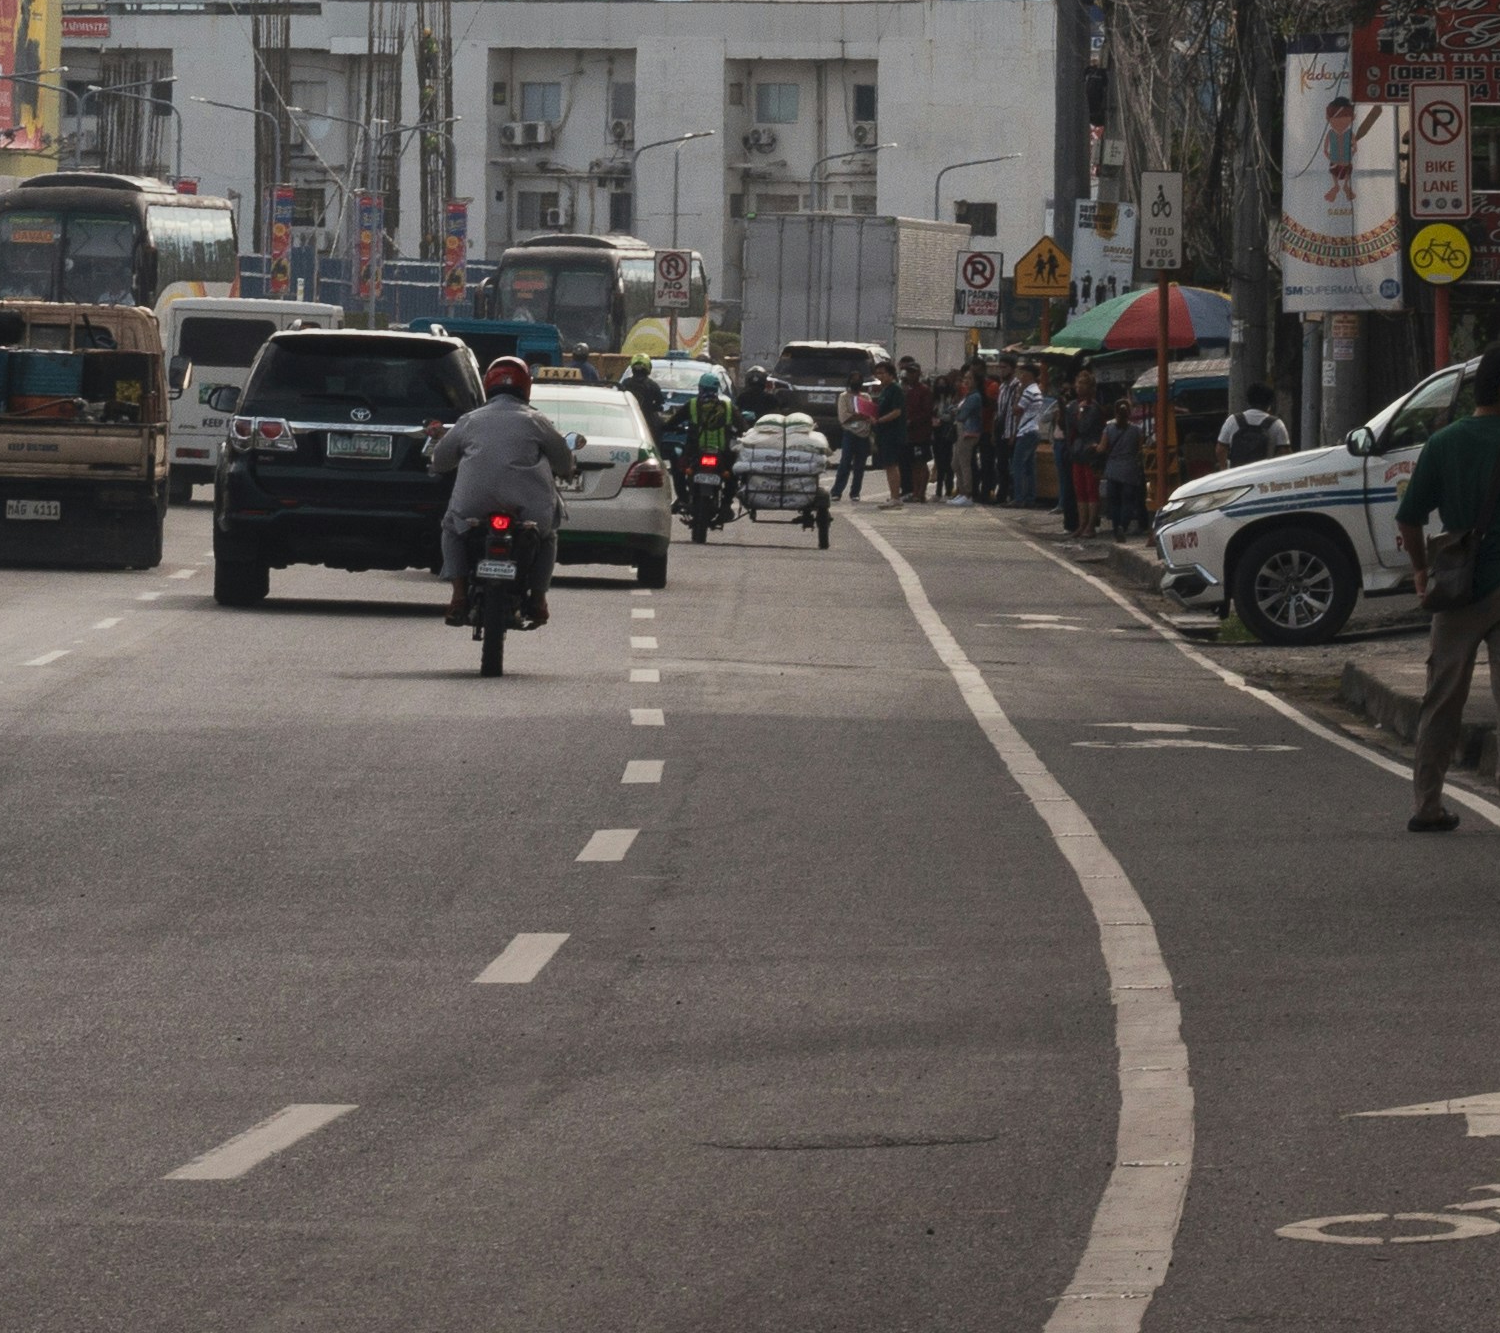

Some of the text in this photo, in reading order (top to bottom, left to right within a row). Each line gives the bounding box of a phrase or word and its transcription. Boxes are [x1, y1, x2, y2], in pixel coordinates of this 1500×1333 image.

[1405, 52, 1446, 63] CAR
[1425, 160, 1456, 174] BIKE
[1422, 180, 1458, 193] LANE
[1148, 227, 1175, 237] YIELD
[1155, 239, 1168, 248] TO
[1149, 248, 1174, 258] PEDS
[543, 369, 578, 379] TAXI
[202, 418, 224, 428] KEEP
